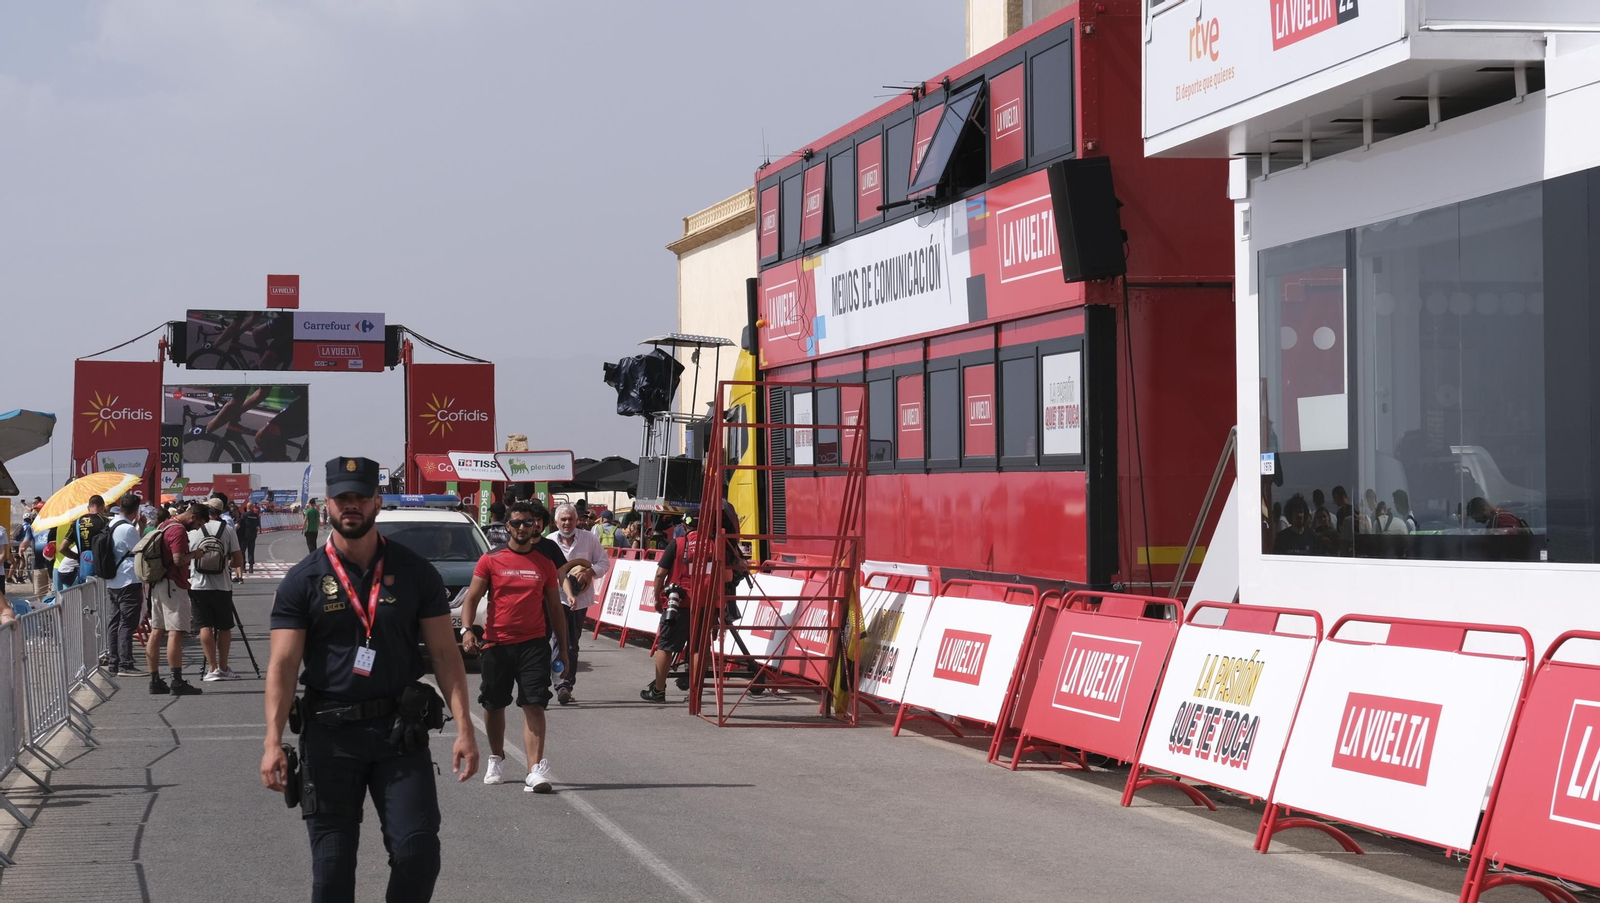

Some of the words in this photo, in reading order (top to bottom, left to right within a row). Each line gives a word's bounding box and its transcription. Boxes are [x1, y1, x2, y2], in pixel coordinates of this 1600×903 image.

[1276, 0, 1289, 40] LA
[1189, 17, 1220, 62] rtve
[1175, 85, 1182, 102] El
[1182, 78, 1202, 100] deporte
[1202, 75, 1214, 94] que
[1213, 66, 1235, 87] quieres
[1003, 221, 1016, 267] LA
[1015, 209, 1056, 263] VUELTA
[831, 270, 860, 317] MEDIOS
[861, 265, 872, 310] DE
[873, 234, 942, 306] COMUNICACIÓN
[303, 321, 351, 331] Carrefour
[769, 297, 777, 330] LA
[775, 291, 797, 327] VUELTA
[322, 347, 330, 356] LA
[330, 347, 357, 356] VUELTA
[100, 407, 153, 421] Cofidis
[437, 409, 489, 422] Cofidis
[118, 461, 142, 470] plenitude
[473, 460, 499, 469] TISS
[530, 463, 566, 471] plenitude
[190, 485, 210, 493] Cofidis
[480, 489, 489, 527] ŠKODA
[937, 637, 954, 670] LA
[947, 638, 985, 676] VUELTA
[1060, 647, 1085, 695] LA
[1076, 650, 1130, 704] VUELTA
[1193, 653, 1220, 699] LA
[1209, 649, 1265, 707] PASIÓN
[1168, 701, 1205, 755] QUE
[1194, 705, 1223, 761] TE
[1213, 709, 1260, 770] TOCA
[1338, 705, 1367, 757] LA
[1361, 708, 1430, 769] VUELTA
